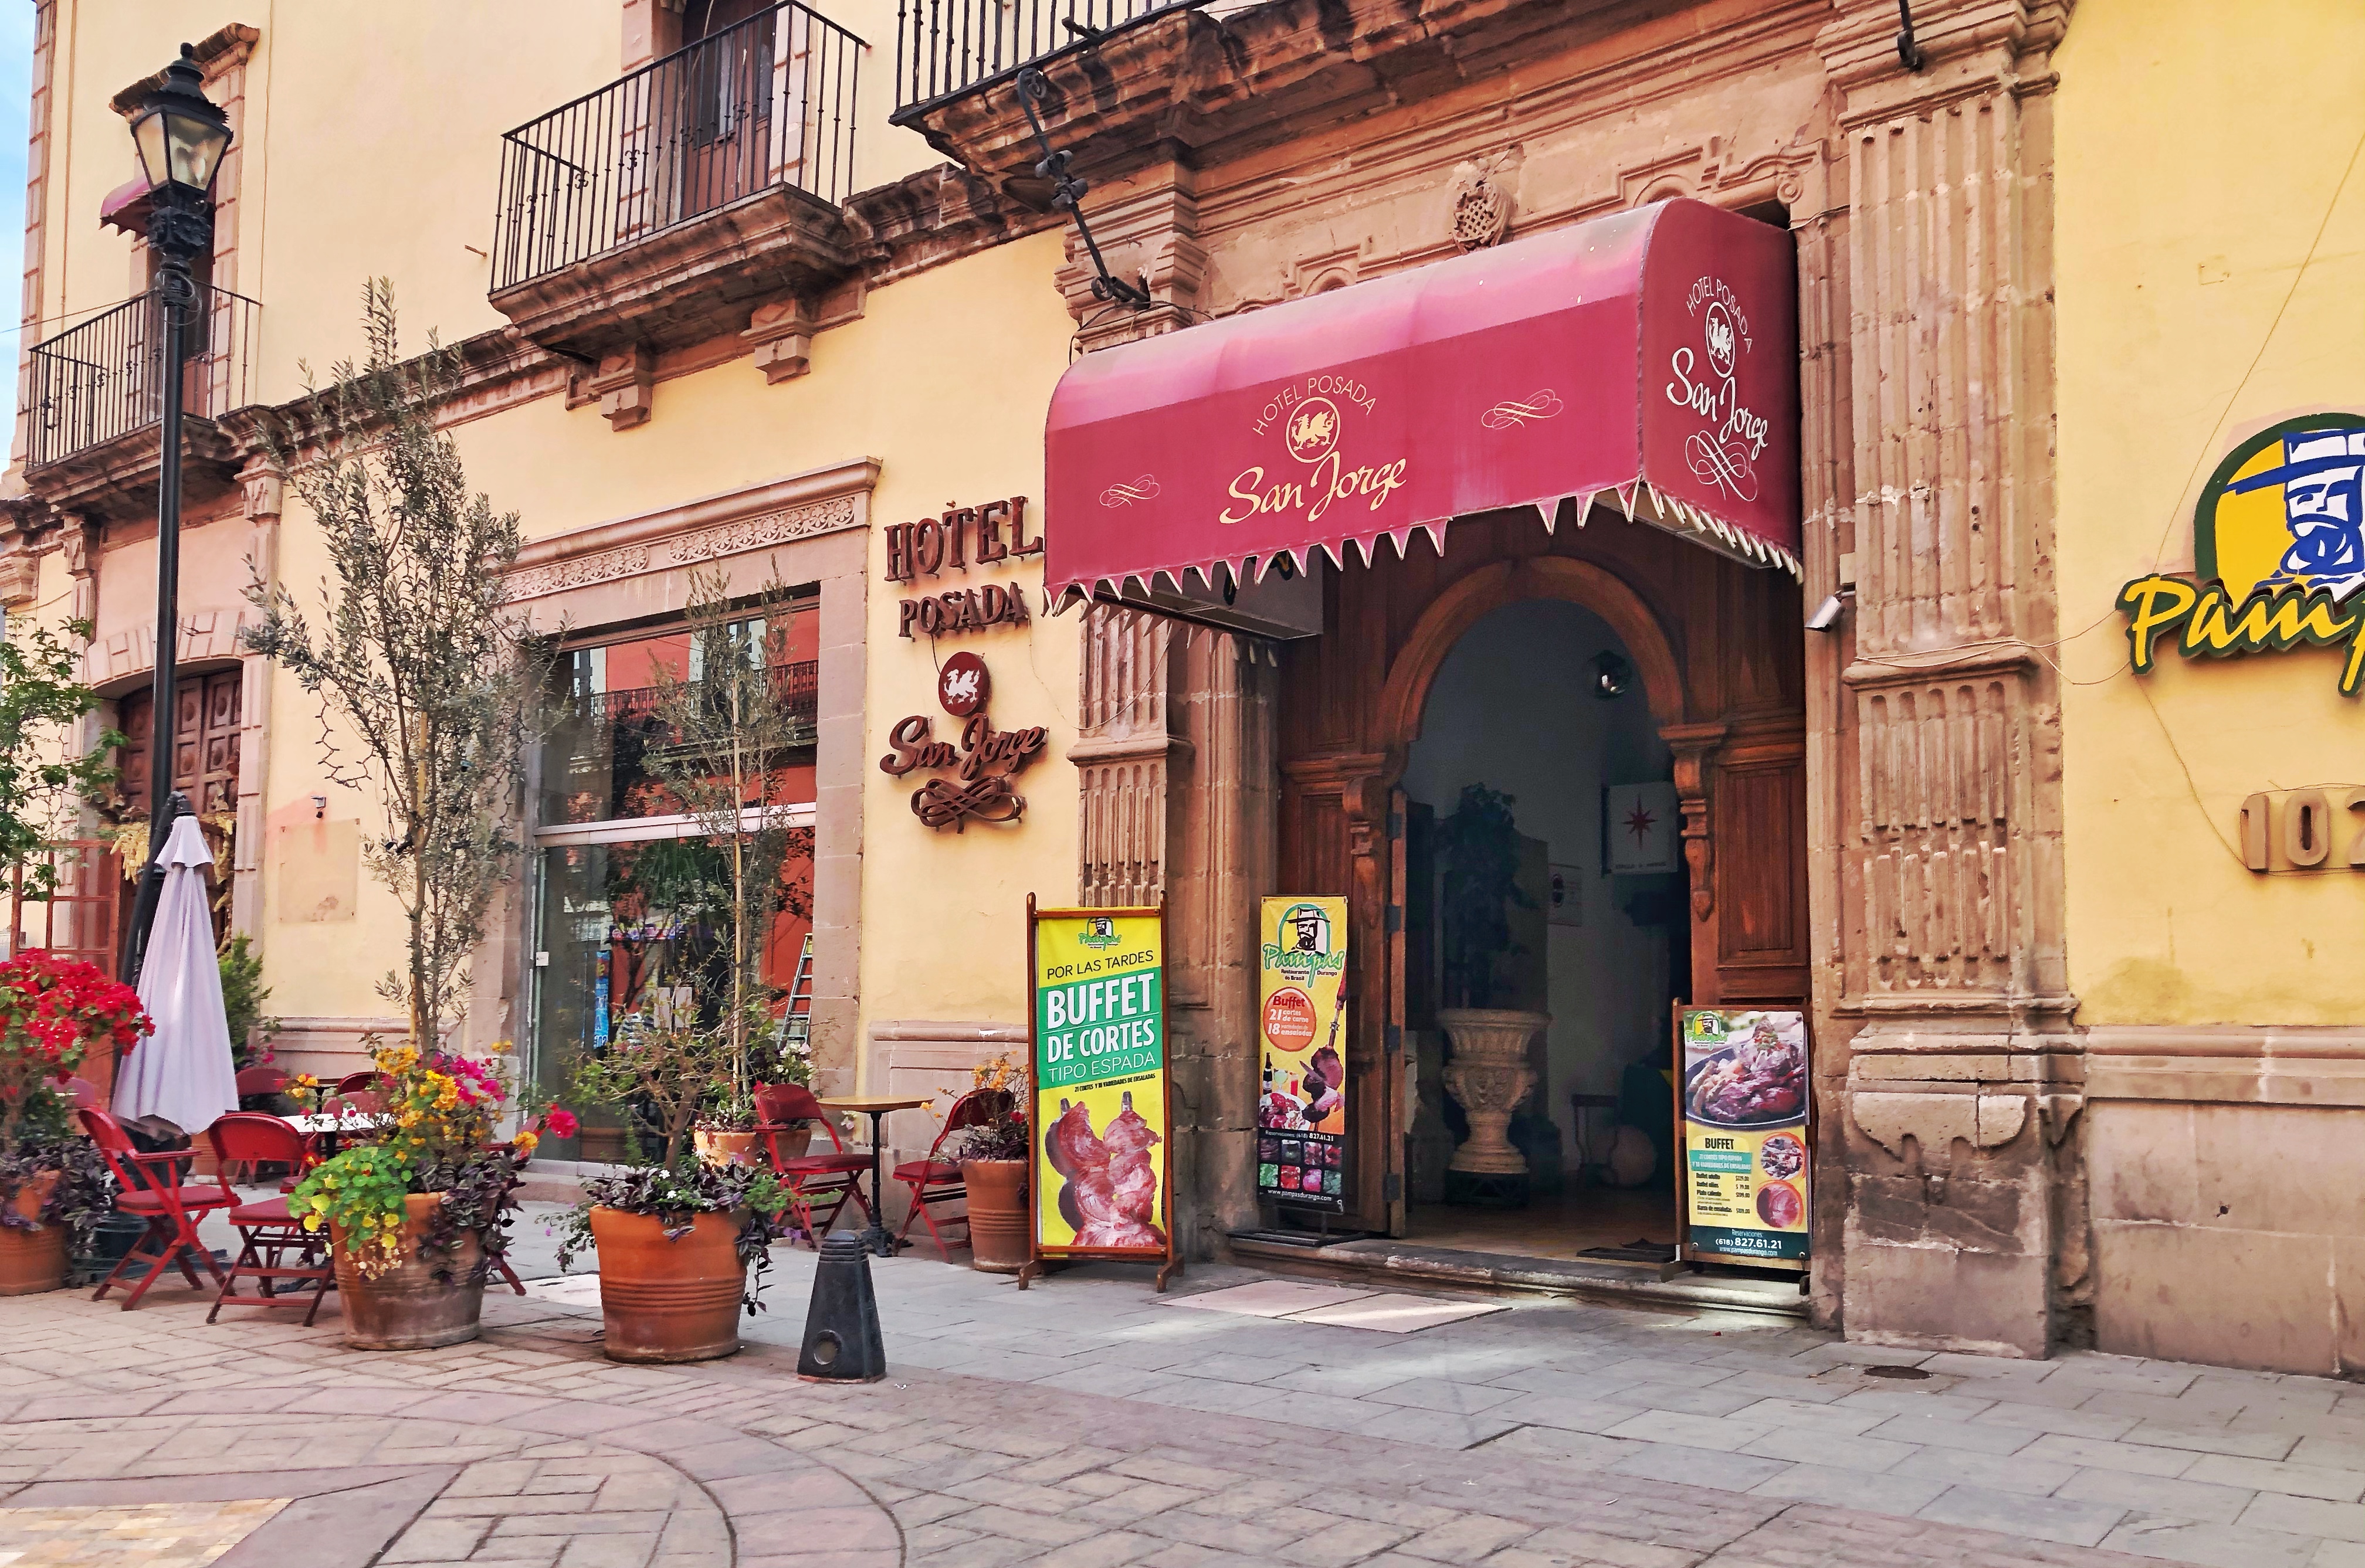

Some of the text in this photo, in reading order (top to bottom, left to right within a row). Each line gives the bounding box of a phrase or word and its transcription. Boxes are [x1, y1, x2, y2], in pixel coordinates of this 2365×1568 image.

[1686, 276, 1753, 353] HOTEL POSADA
[1252, 375, 1376, 436] HOTEL POSADA
[1666, 347, 1768, 461] San Jorge
[1219, 451, 1407, 524] San Jorge
[885, 495, 1043, 582] HOTEL
[899, 582, 1030, 639] POSADA
[880, 712, 1048, 781] San Jorge
[1047, 950, 1154, 980] POR LAS TARDES
[1263, 943, 1345, 988] Pampas
[1047, 972, 1154, 1030] BUFFET
[1269, 1009, 1282, 1020] 21
[1273, 996, 1305, 1009] Buffet
[1047, 1018, 1155, 1063] DE CORTES
[1268, 1023, 1280, 1034] 18
[1048, 1051, 1156, 1082] TIPO ESPADA
[1705, 1138, 1734, 1149] BUFFET
[1268, 1189, 1332, 1201] www.pampasdurango.com
[1734, 1237, 1782, 1249] 827.61.21
